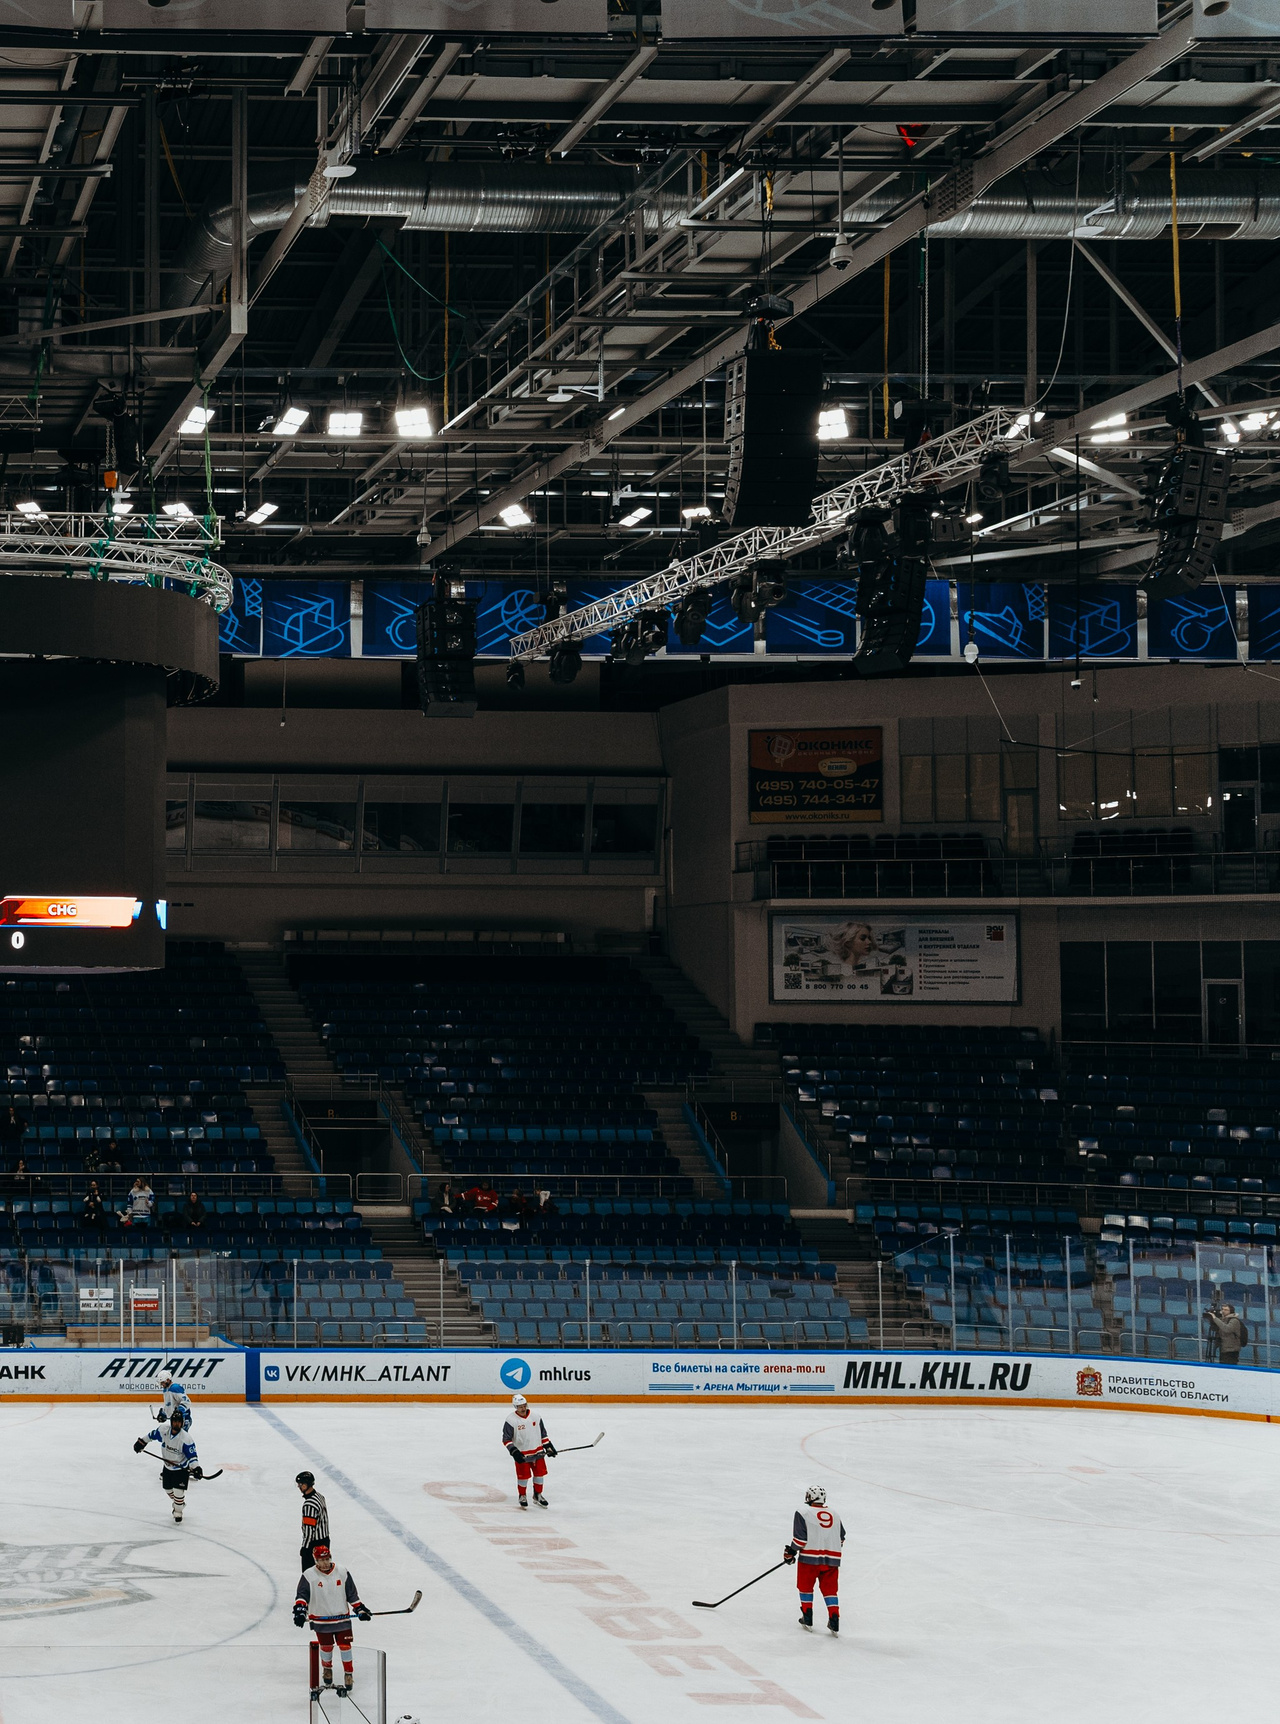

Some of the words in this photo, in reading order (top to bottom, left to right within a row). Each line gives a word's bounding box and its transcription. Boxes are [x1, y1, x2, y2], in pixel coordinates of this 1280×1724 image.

[797, 740, 874, 750] ОКОНИКС
[756, 780, 794, 792] (495)
[800, 779, 879, 790] 740-05-47
[760, 795, 798, 806] (495)
[801, 793, 876, 805] 744-34-17
[785, 812, 850, 821] www.okoniks.ru
[47, 904, 77, 916] CHG
[11, 931, 25, 949] 0
[97, 1358, 226, 1378] АТЛАНТ
[284, 1365, 451, 1383] VK/MHK_ATLANT
[539, 1366, 592, 1381] mhlrus
[652, 1363, 672, 1373] Все
[674, 1362, 712, 1374] билеты
[715, 1365, 728, 1373] на
[730, 1363, 760, 1373] сайте
[763, 1363, 826, 1374] arena-mo.ru
[843, 1361, 1032, 1391] MHL.KHL.RU
[1108, 1375, 1195, 1389] ПРАВИТЕЛЬСТВО
[1108, 1385, 1177, 1398] МОСКОВСКОЙ
[1180, 1390, 1229, 1403] ОБЛАСТИ
[816, 1510, 834, 1528] 9
